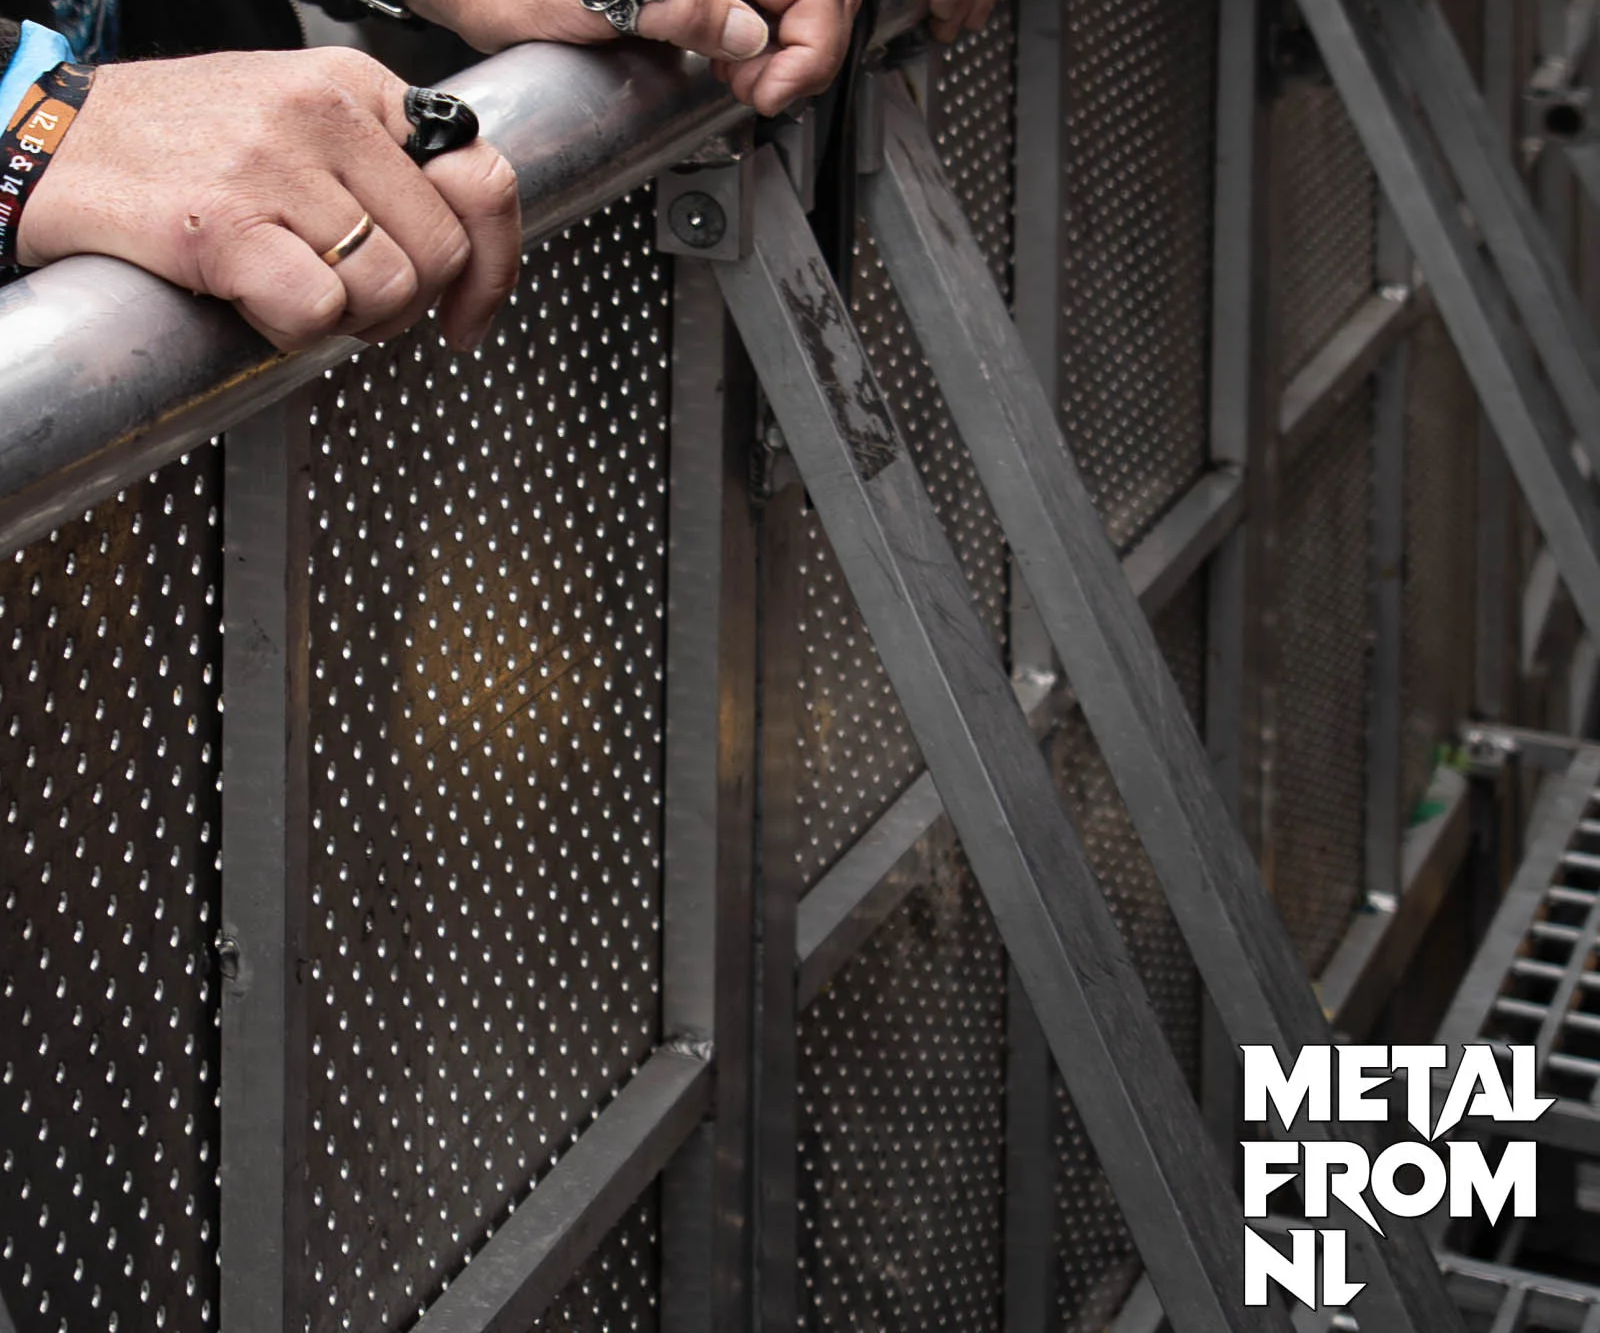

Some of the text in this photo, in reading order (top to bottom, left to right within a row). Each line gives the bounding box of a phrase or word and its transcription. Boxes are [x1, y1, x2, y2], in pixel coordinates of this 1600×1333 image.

[19, 133, 45, 155] 13
[8, 155, 33, 173] &
[0, 174, 24, 196] 14
